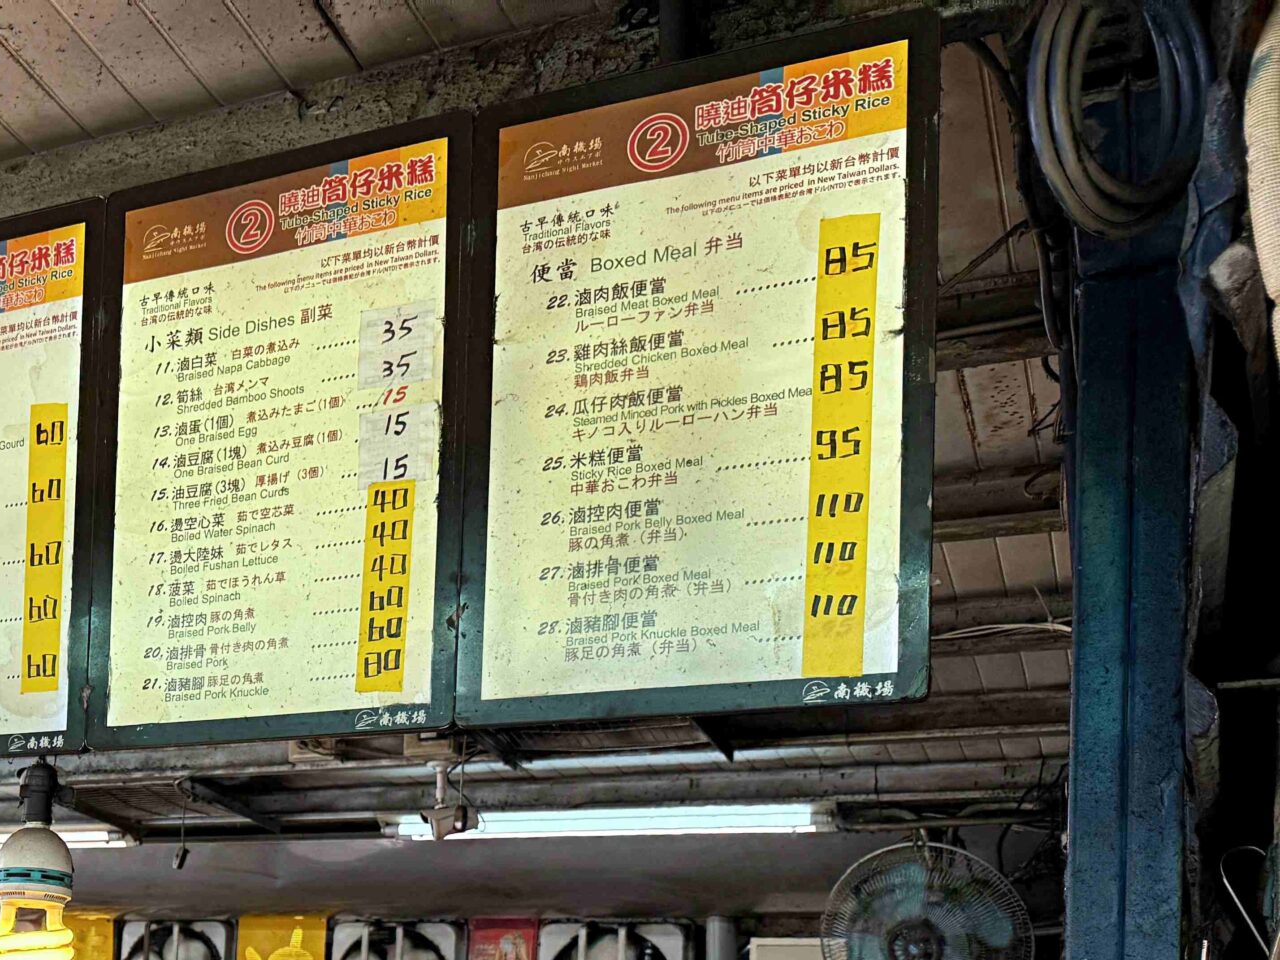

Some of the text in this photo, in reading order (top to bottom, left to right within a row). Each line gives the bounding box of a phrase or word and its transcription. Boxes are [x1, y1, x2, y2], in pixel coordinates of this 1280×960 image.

[696, 93, 890, 146] Tube-Shaped Sticky Rice
[362, 191, 400, 212] Sticky
[403, 184, 432, 202] Rice
[519, 203, 615, 233] 古早傳統口味
[522, 218, 611, 242] Traditional Flavors
[590, 249, 646, 274] Boxed
[653, 240, 697, 264] Meal
[704, 231, 744, 255] 弁当
[823, 237, 877, 276] 85
[574, 284, 719, 319] Braised Meat Boxed Meal
[208, 322, 240, 341] Side
[244, 311, 295, 334] Dishes
[299, 302, 333, 325] 副菜
[380, 313, 418, 344] 35
[820, 305, 873, 341] 85
[176, 353, 290, 383] Braised Napa Cabbage
[381, 349, 417, 380] 35
[818, 359, 869, 395] 85
[176, 384, 304, 415] Shredded Bamboo Shoots
[382, 384, 408, 405] 15
[572, 386, 812, 427] Steamed Minced Pork with Pickles Boxed Mea
[384, 409, 410, 437] 15
[813, 425, 862, 462] 95
[382, 452, 408, 481] 15
[570, 454, 703, 483] Sticky Rice Boxed Meal
[30, 477, 61, 504] 60
[371, 487, 409, 513] 40
[814, 491, 865, 518] 110
[170, 520, 275, 543] Boiled Water Spinach
[370, 518, 408, 547] 40
[569, 507, 745, 537] Braised Pork Belly Boxed Meal
[28, 539, 63, 567] 60
[369, 551, 408, 582] 40
[811, 540, 858, 564] 110
[367, 585, 404, 612] 60
[809, 593, 859, 618] 110
[367, 615, 403, 642] 60
[25, 652, 57, 679] 60
[363, 647, 402, 678] 80
[834, 680, 895, 700] 南機場
